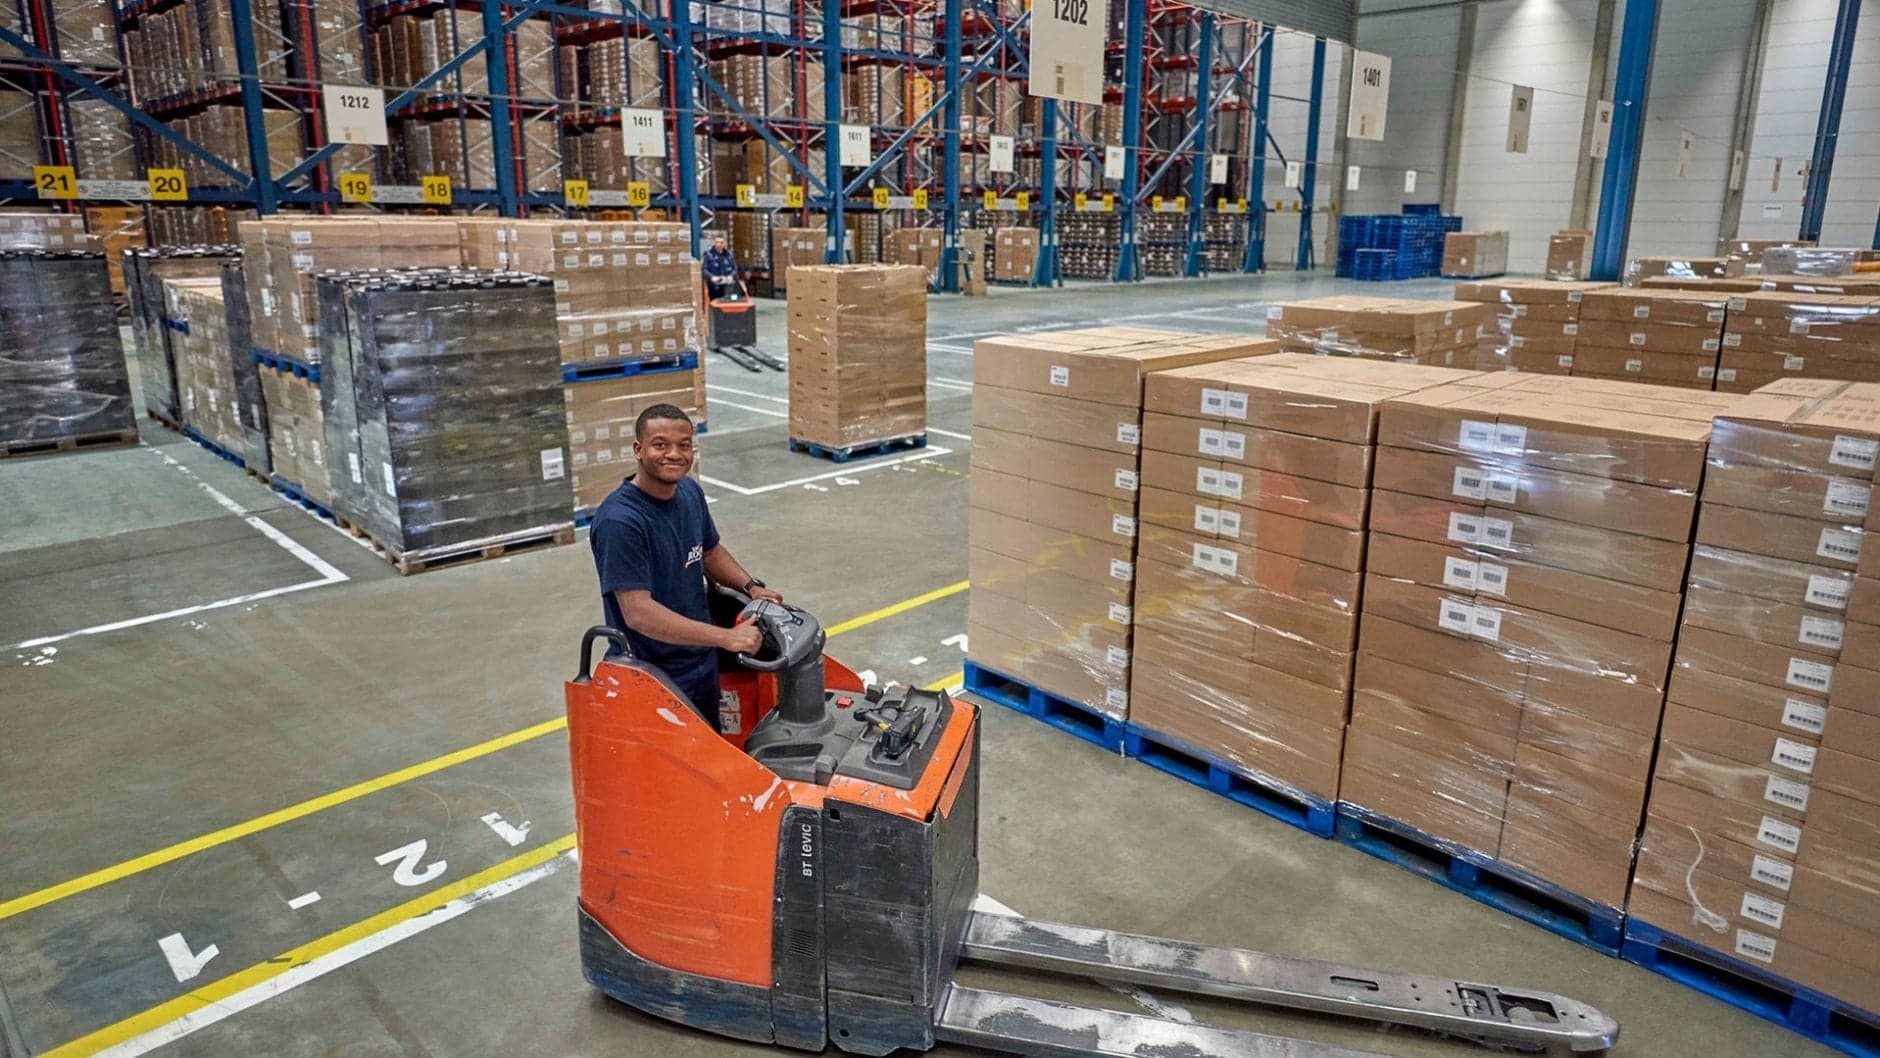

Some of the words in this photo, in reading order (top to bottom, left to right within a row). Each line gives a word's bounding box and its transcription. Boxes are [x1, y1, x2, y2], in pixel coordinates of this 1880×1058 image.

[1054, 0, 1088, 26] 1202
[1363, 67, 1381, 88] 1401
[340, 95, 370, 109] 1212
[633, 116, 653, 128] 1411
[41, 174, 69, 191] 21
[154, 176, 182, 193] 20
[346, 180, 367, 195] 19
[427, 182, 448, 197] 18
[569, 187, 585, 199] 17
[632, 188, 647, 200] 16
[789, 192, 801, 202] 14
[802, 861, 812, 876] BT
